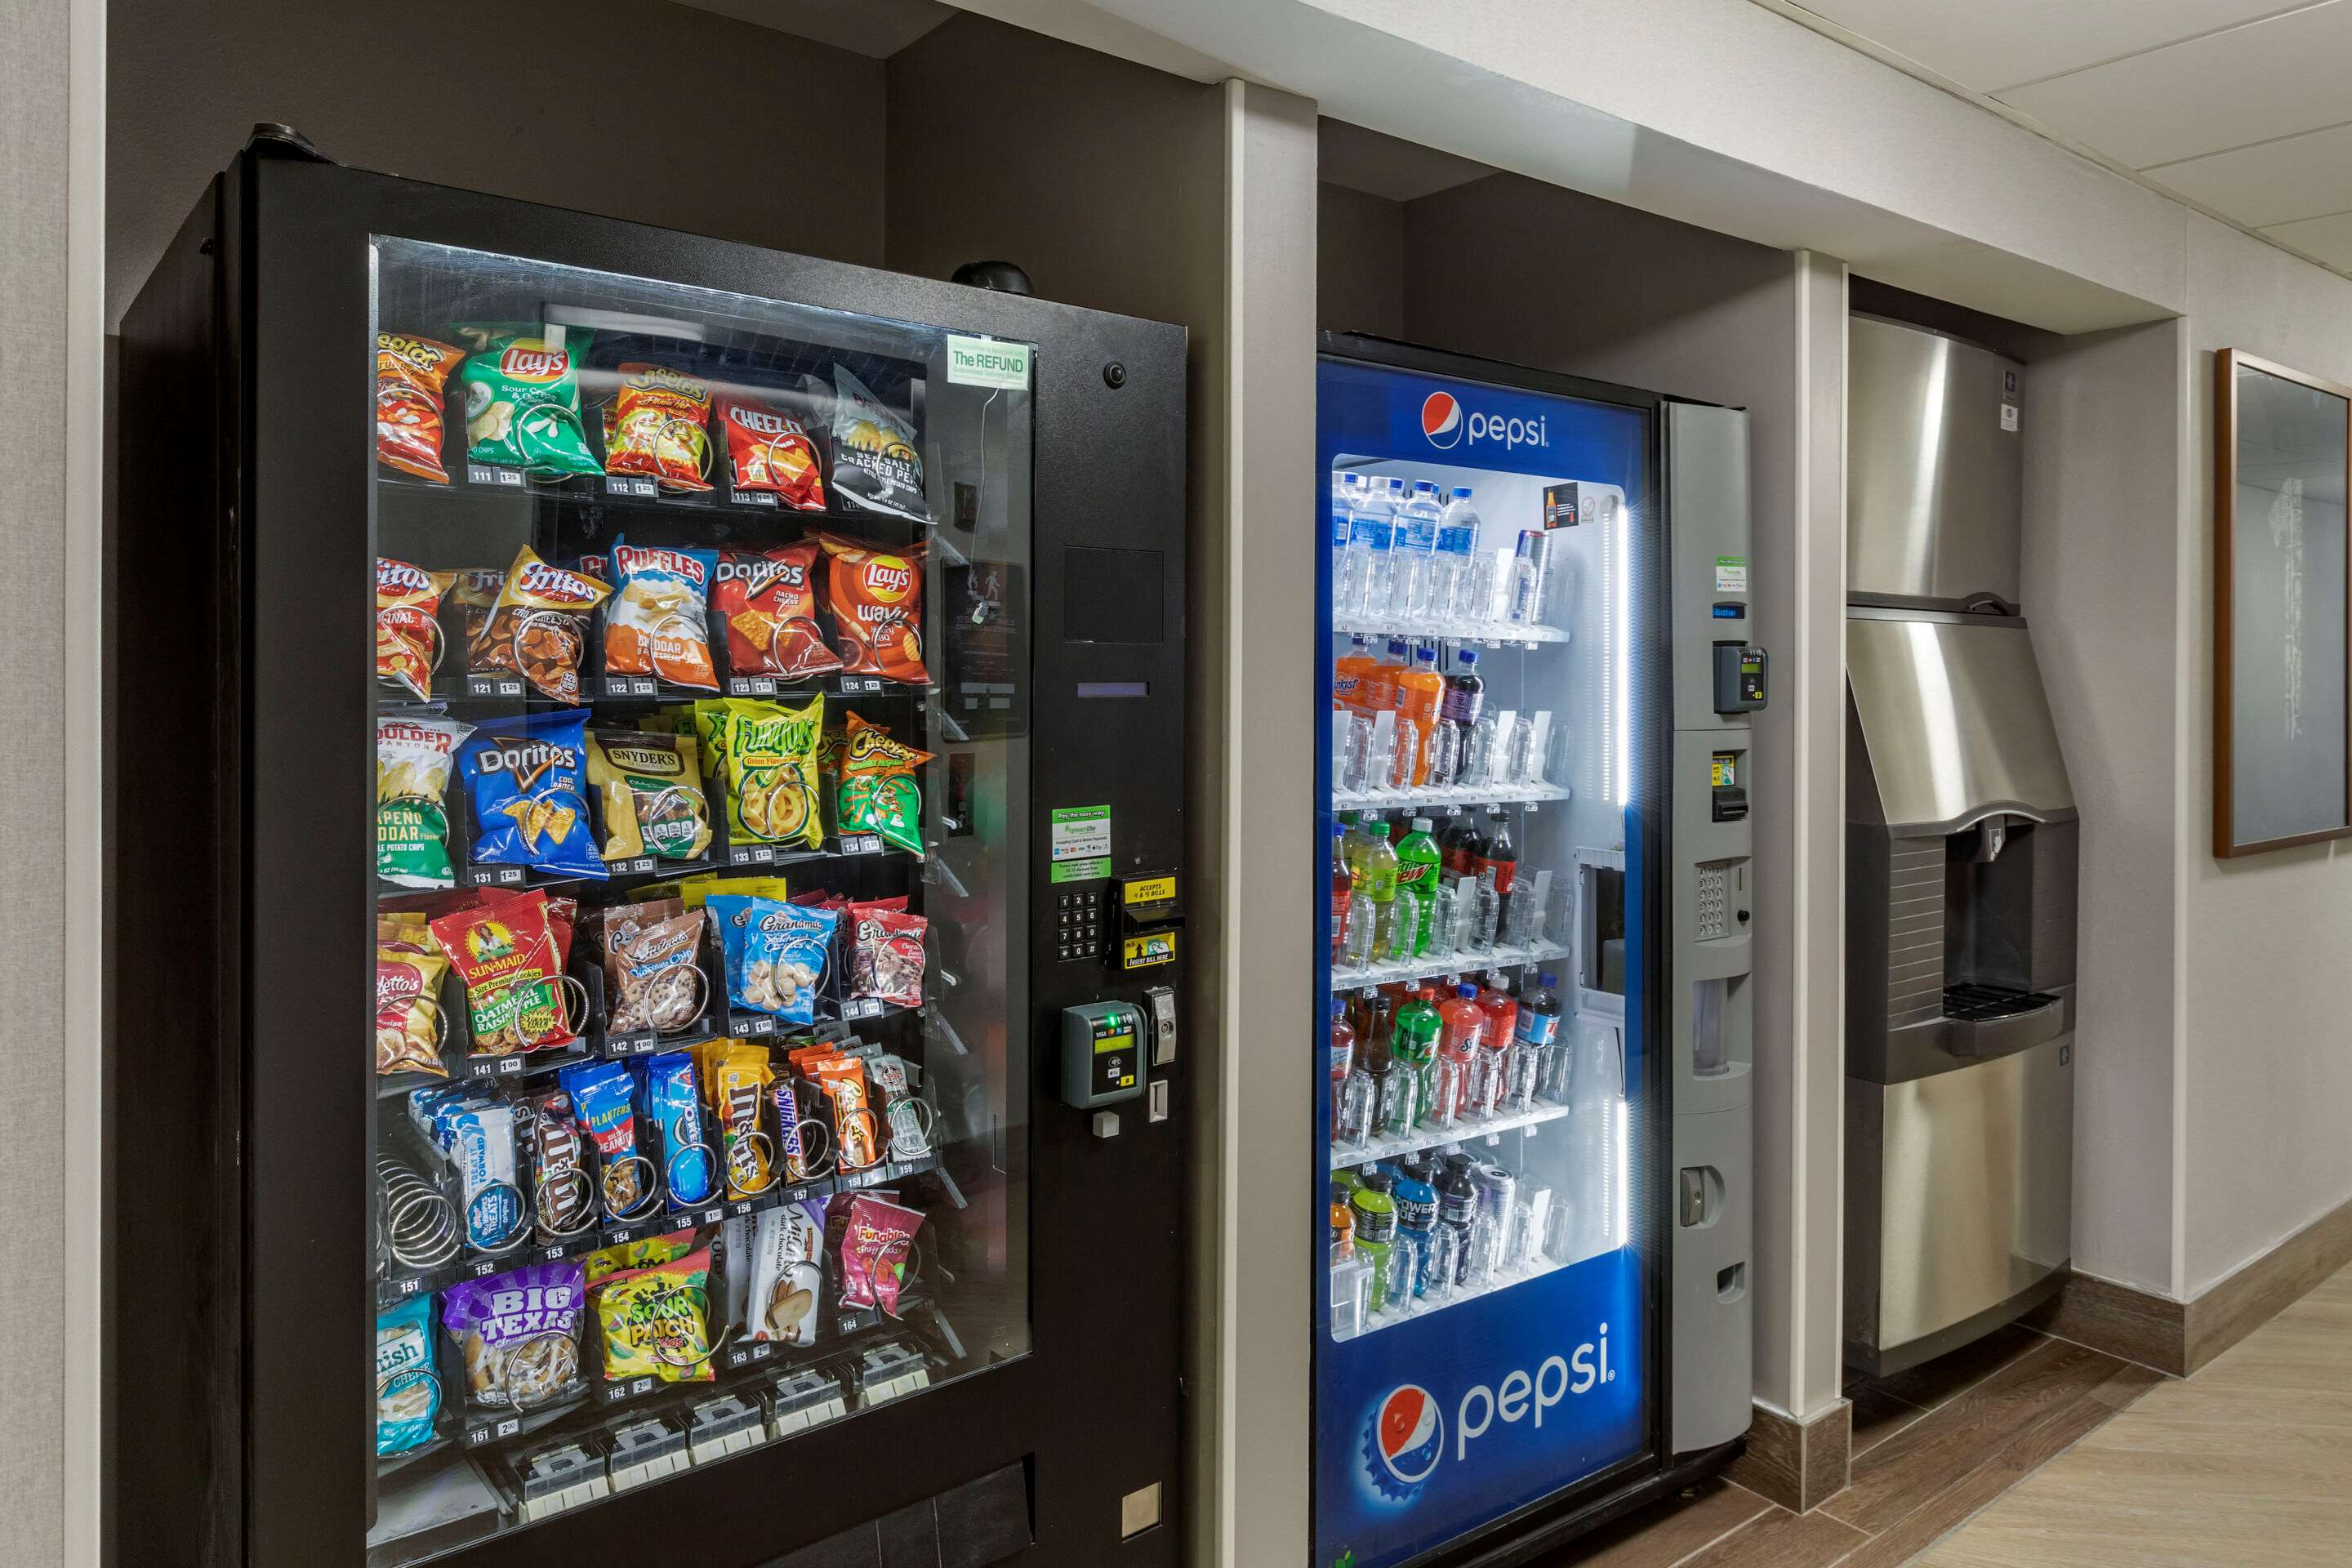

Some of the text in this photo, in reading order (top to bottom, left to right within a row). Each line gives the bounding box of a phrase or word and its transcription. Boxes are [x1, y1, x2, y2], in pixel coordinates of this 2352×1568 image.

[504, 349, 568, 376] Lay's
[953, 351, 1024, 372] The REFUND
[501, 385, 527, 393] Sour
[730, 408, 803, 434] CHEEZ-IT
[1468, 412, 1547, 451] pepsi
[474, 472, 491, 481] 111
[612, 483, 628, 492] 112
[734, 492, 751, 502] 113
[614, 546, 705, 585] RUFFLES
[716, 561, 804, 585] Doritos
[867, 564, 910, 591] Lay's
[519, 562, 596, 603] Fritos
[775, 590, 799, 599] NACHO
[858, 604, 909, 628] wavy
[474, 684, 491, 693] 121
[611, 684, 627, 693] 122
[735, 684, 750, 693] 123
[844, 681, 859, 691] 124
[1333, 677, 1359, 691] unkist
[848, 726, 920, 762] Cheetos
[479, 744, 576, 774] Doritos
[612, 749, 676, 766] SNYDER'S
[386, 843, 425, 853] POTATO CHIPS
[844, 843, 859, 853] 134
[734, 853, 750, 862] 133
[612, 862, 628, 872] 132
[474, 873, 491, 883] 131
[1139, 884, 1162, 892] ACCEPTS
[670, 948, 693, 964] Chip
[474, 984, 488, 995] Size
[515, 969, 541, 982] Cookies
[844, 1006, 859, 1017] 144
[734, 1023, 750, 1034] 143
[611, 1041, 628, 1052] 142
[473, 1064, 491, 1076] 141
[591, 1103, 631, 1126] PLANTERS
[775, 1089, 801, 1156] SNICKERS
[477, 1137, 488, 1183] FORWARD
[899, 1164, 914, 1174] 159
[793, 1190, 808, 1201] 157
[488, 1195, 498, 1234] TREATS
[737, 1203, 751, 1214] 156
[676, 1217, 693, 1229] 155
[612, 1231, 630, 1244] 154
[546, 1247, 564, 1259] 153
[775, 1234, 786, 1272] chocolate
[475, 1263, 494, 1276] 152
[400, 1281, 419, 1293] 151
[492, 1286, 572, 1316] BIG
[630, 1294, 694, 1322] SOUR
[482, 1311, 575, 1342] TEXAS
[628, 1315, 696, 1347] PATCH
[842, 1321, 858, 1331] 164
[732, 1352, 747, 1365] 163
[608, 1388, 626, 1400] 162
[1458, 1321, 1609, 1462] pepsi
[471, 1429, 489, 1444] 161
